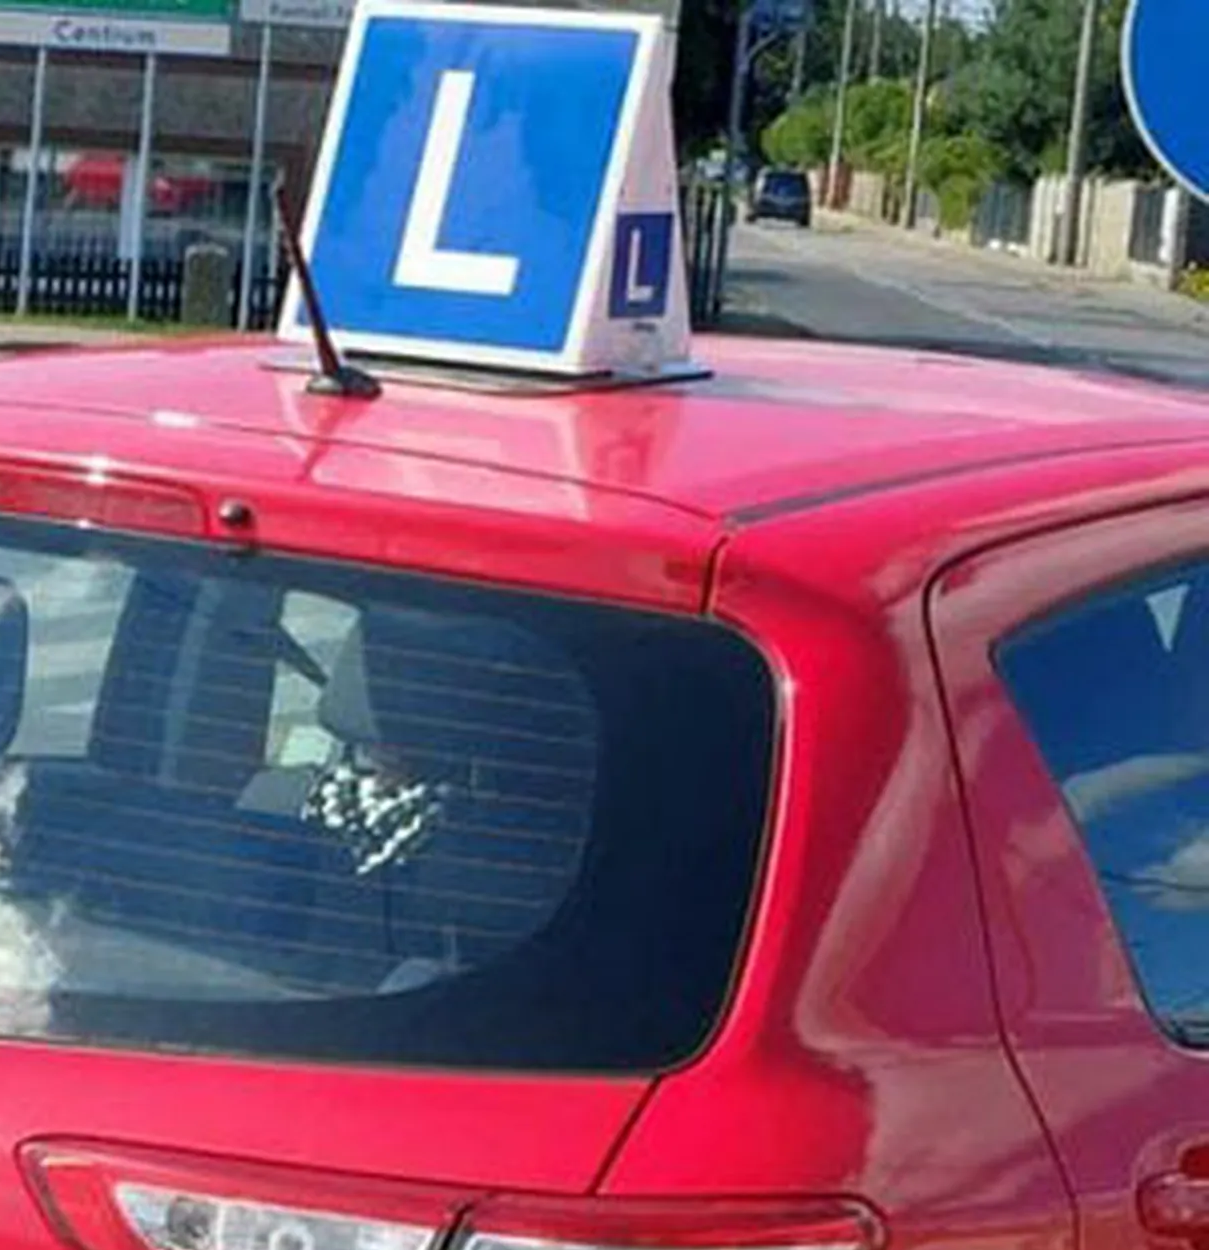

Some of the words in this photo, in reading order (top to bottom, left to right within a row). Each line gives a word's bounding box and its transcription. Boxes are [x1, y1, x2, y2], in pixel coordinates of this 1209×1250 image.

[52, 20, 157, 45] Centrum
[392, 71, 520, 296] L
[627, 229, 654, 300] L
